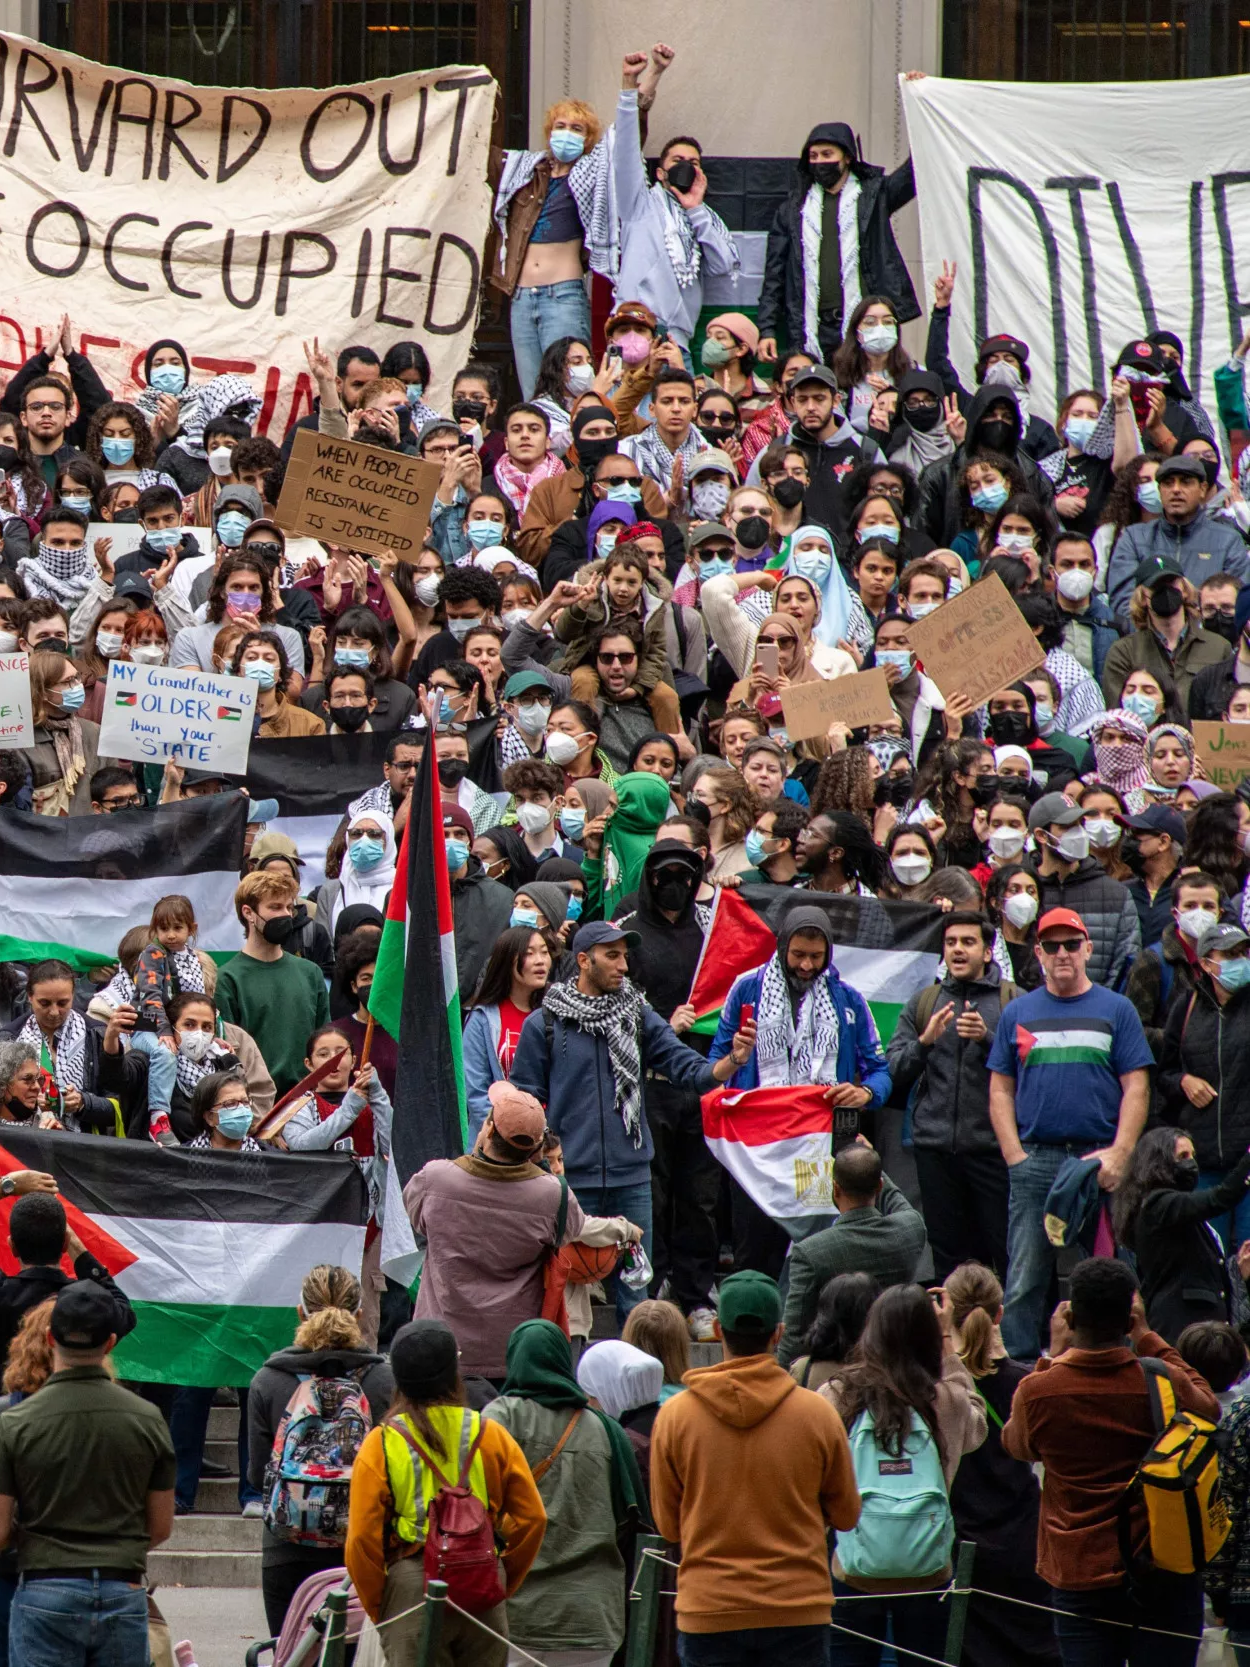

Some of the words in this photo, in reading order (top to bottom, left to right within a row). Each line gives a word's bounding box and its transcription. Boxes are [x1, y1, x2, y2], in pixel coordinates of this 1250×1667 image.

[300, 75, 493, 183] OUT
[26, 200, 480, 335] OCCUPIED
[317, 443, 359, 467] WHEN
[364, 455, 417, 485] PEOPLE
[306, 487, 391, 522] RESISTANCE
[313, 465, 345, 483] ARE
[349, 475, 419, 505] OCCUPIED
[305, 513, 326, 529] IS
[332, 520, 413, 550] JUSTIFIED
[113, 664, 137, 681] MY
[147, 670, 233, 698] Grandfather
[240, 692, 251, 705] is
[141, 694, 212, 722] OLDER
[129, 718, 161, 735] than
[180, 727, 218, 741] your
